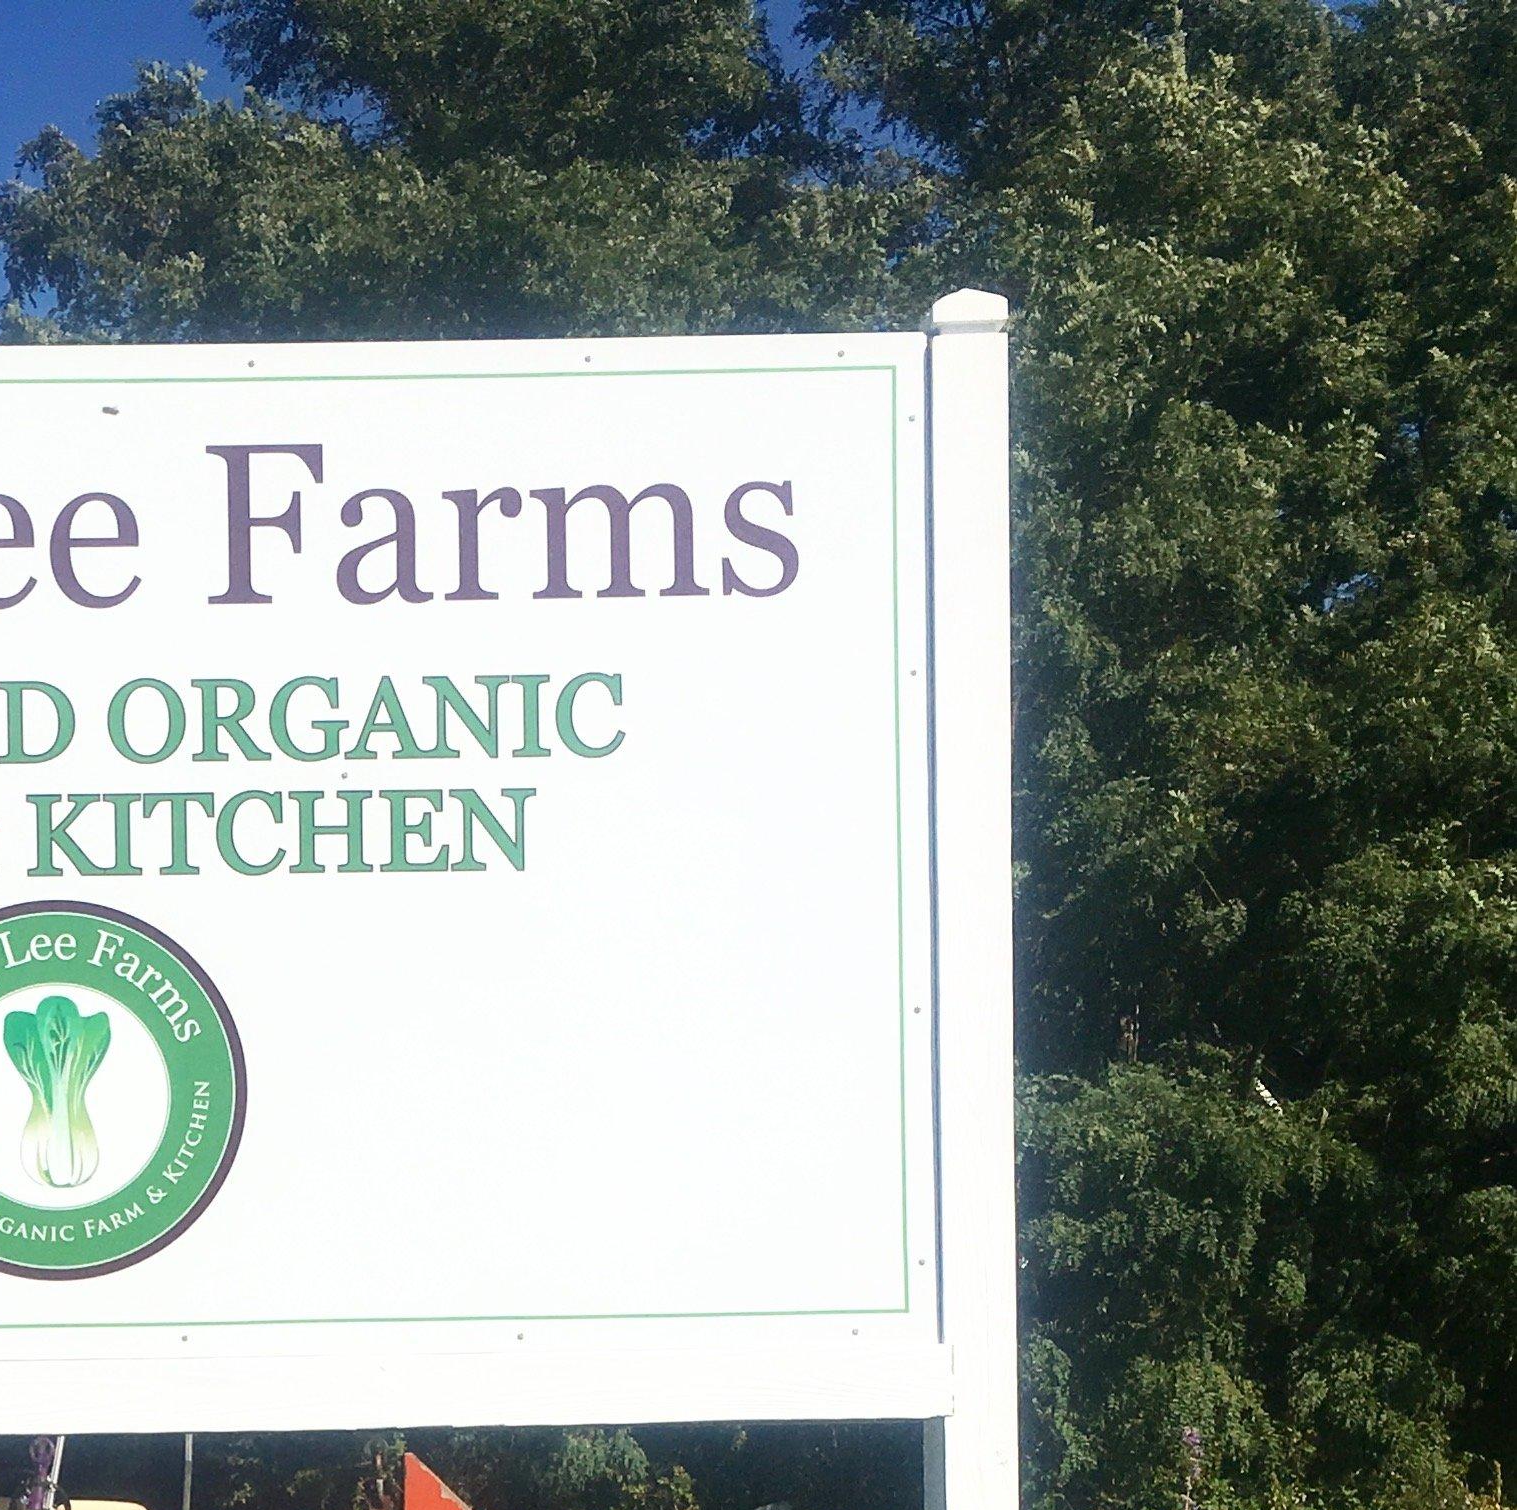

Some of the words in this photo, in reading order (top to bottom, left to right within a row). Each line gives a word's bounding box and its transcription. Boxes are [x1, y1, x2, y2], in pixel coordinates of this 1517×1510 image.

[206, 444, 799, 605] Farms
[107, 672, 626, 764] ORGANIC
[26, 788, 536, 877] KITCHEN
[87, 929, 202, 1043] Farms
[83, 1203, 145, 1239] FARM
[146, 1185, 168, 1204] &
[162, 1081, 210, 1184] KITCHEN
